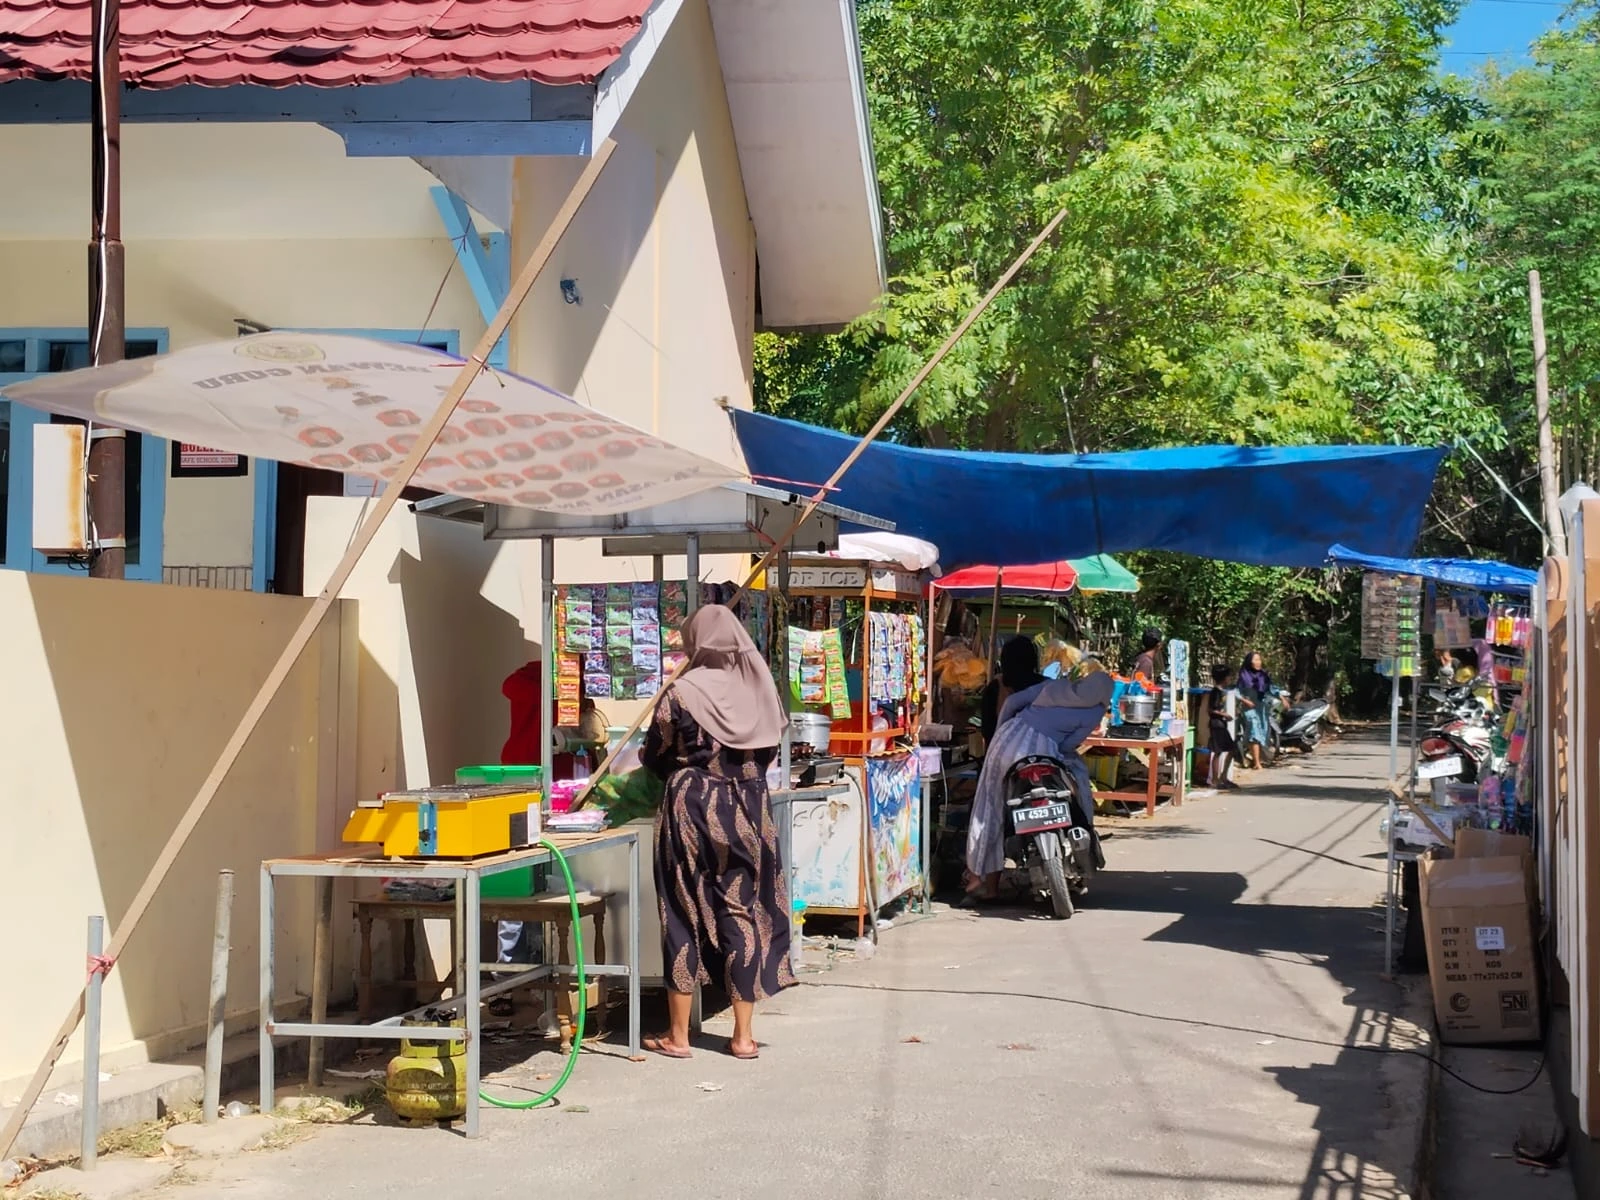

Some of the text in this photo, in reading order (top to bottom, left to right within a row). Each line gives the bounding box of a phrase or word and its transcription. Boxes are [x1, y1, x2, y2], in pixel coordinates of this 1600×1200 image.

[821, 571, 858, 585] ICE
[1028, 808, 1049, 819] 4529
[1502, 993, 1528, 1009] SNI
